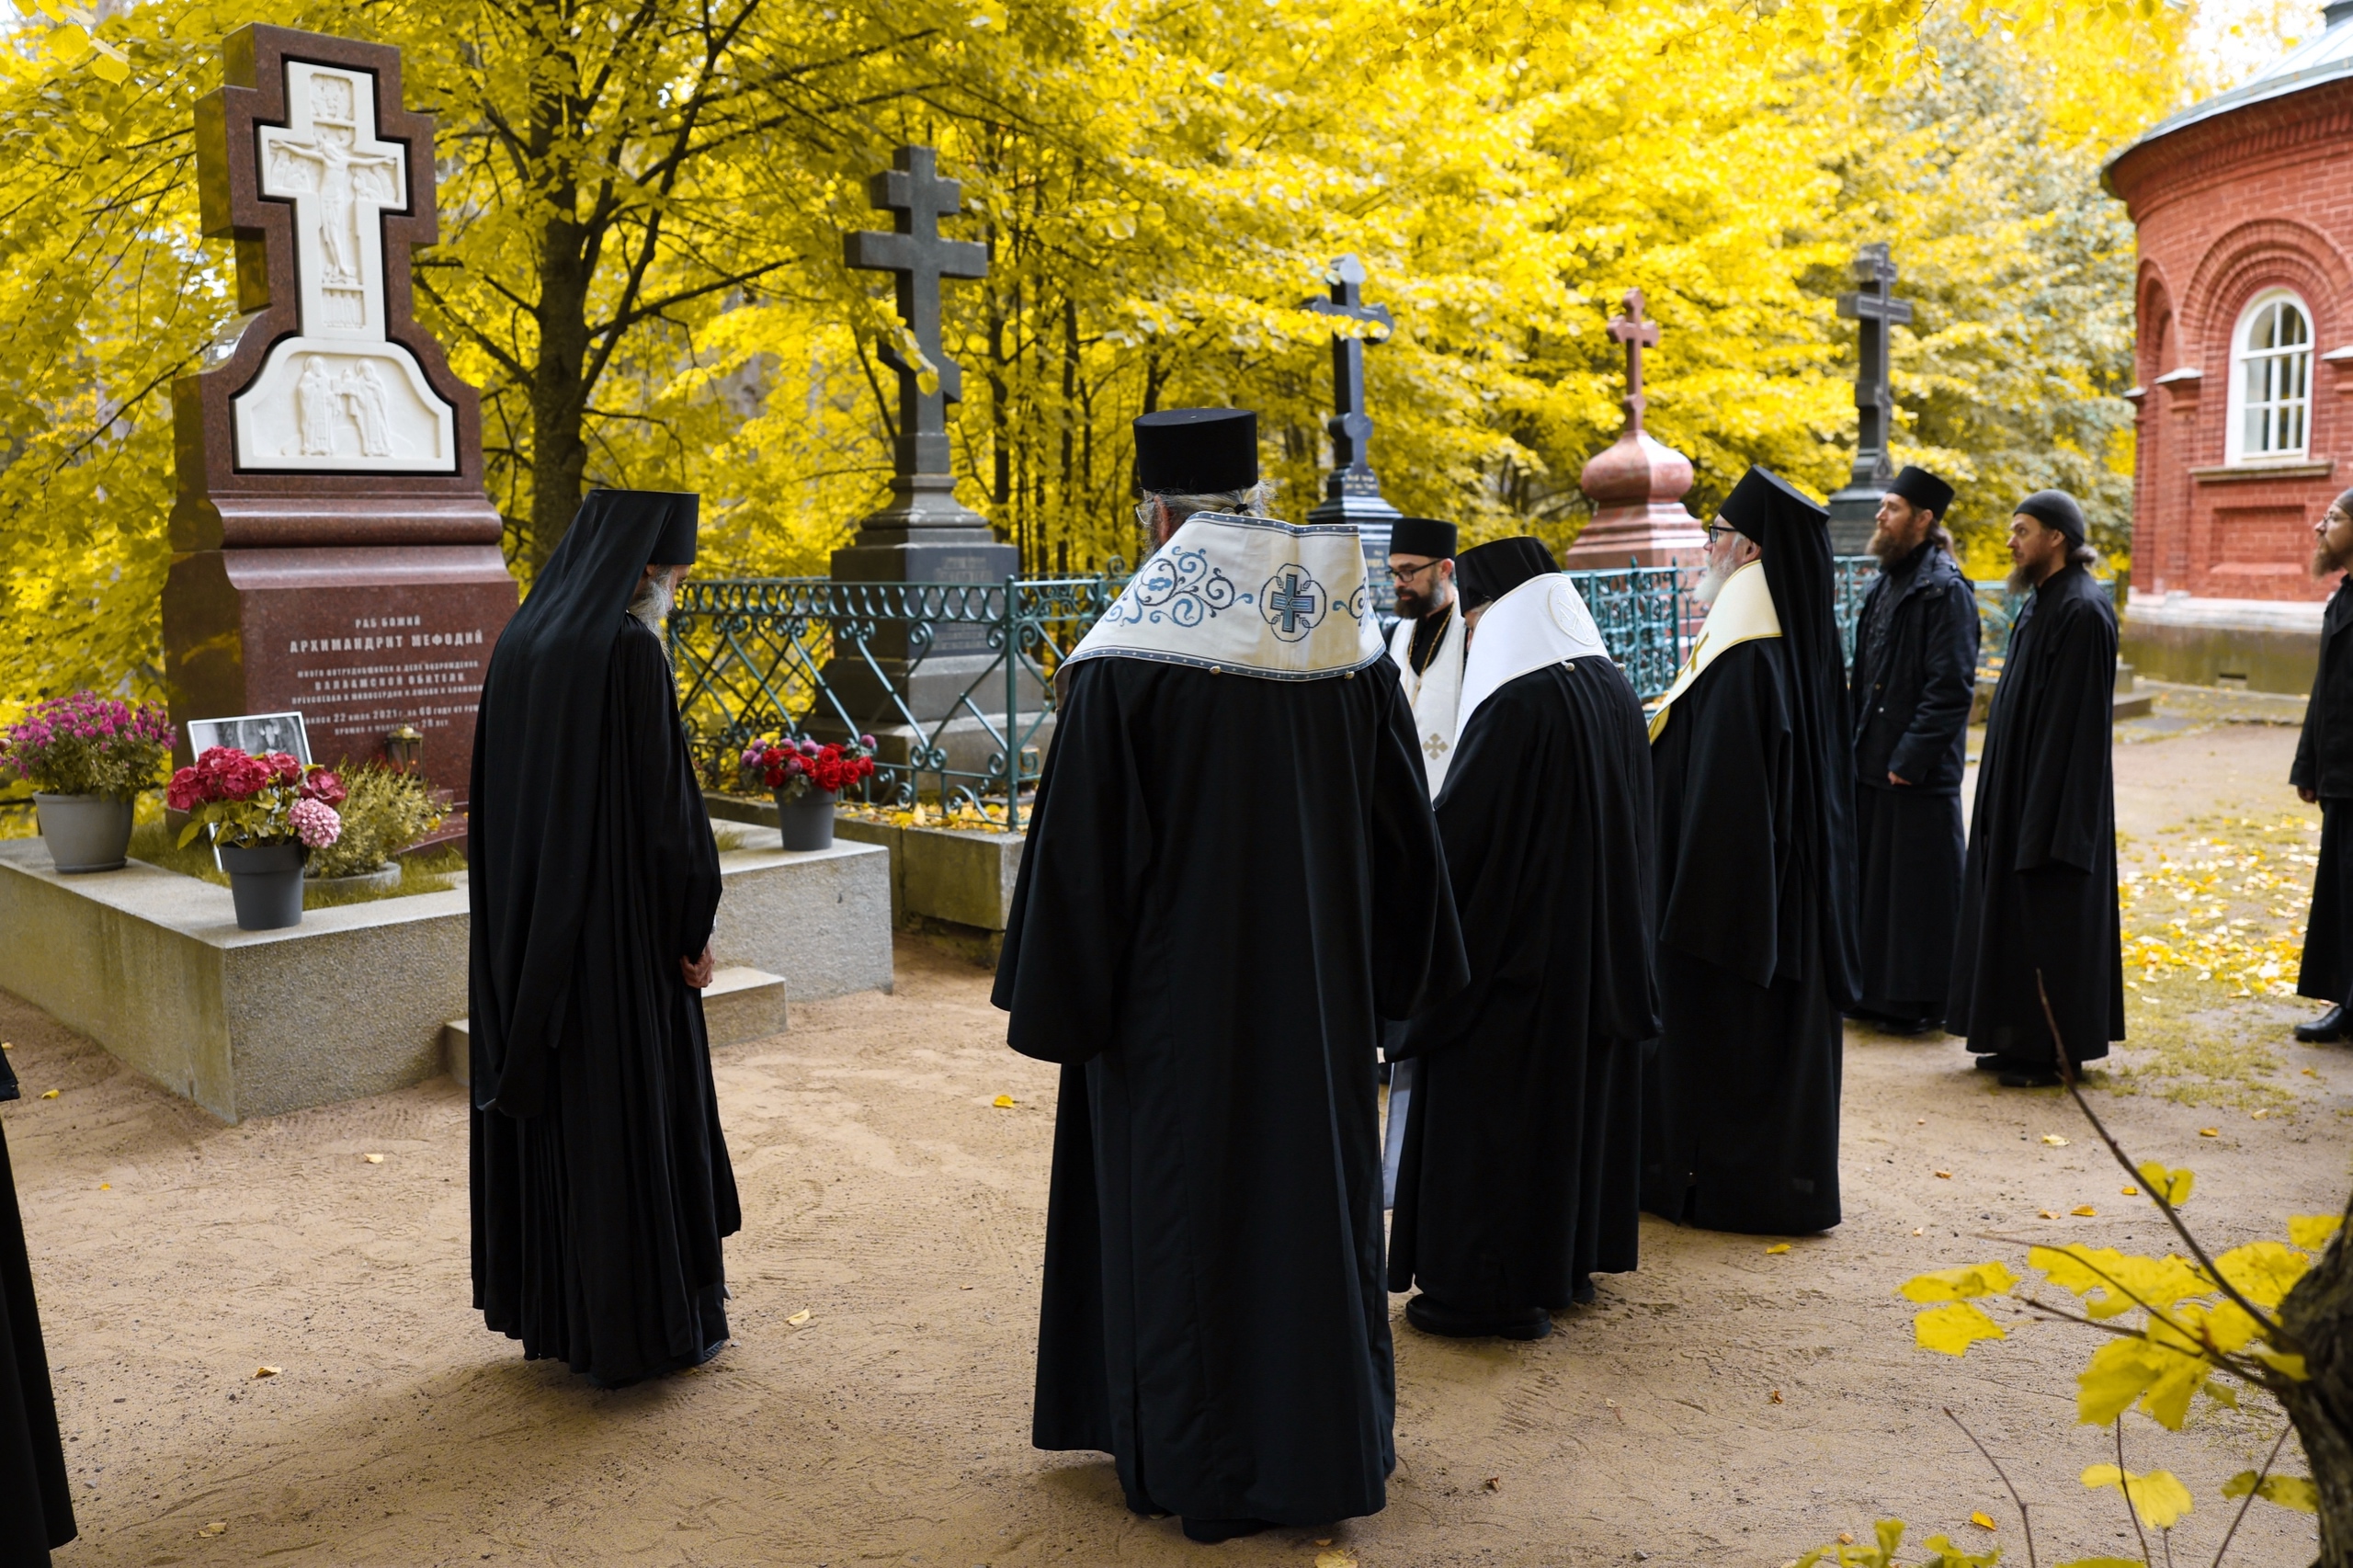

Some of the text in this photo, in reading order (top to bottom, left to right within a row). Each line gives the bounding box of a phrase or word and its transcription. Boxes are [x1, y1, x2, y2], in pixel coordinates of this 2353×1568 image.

[355, 619, 376, 628] РАБ
[290, 629, 483, 653] АРХИМАНДРИТ МЕФОДИЙ
[315, 673, 465, 691] ВАЛААМСКОЙ ОБИТЕЛИ
[373, 708, 397, 719] 2021
